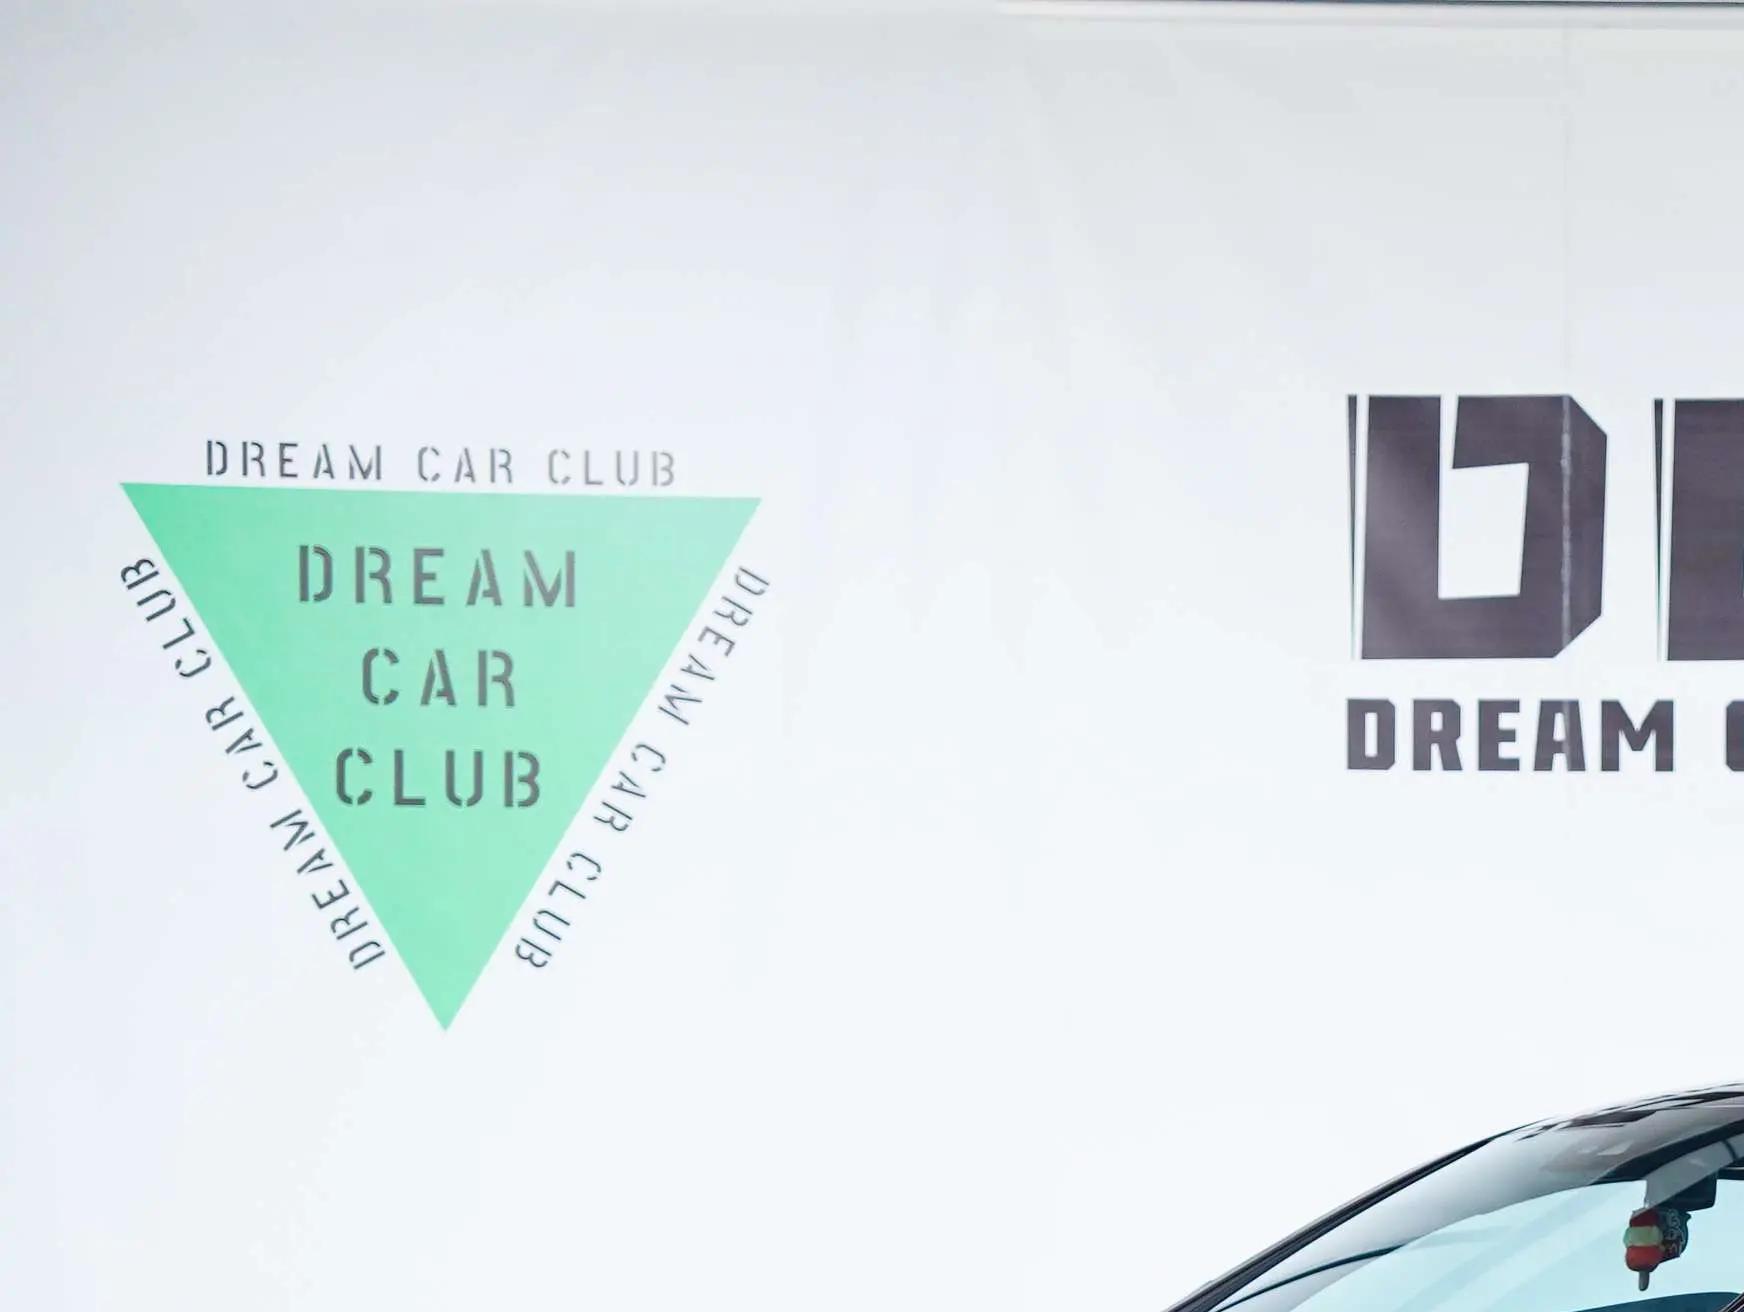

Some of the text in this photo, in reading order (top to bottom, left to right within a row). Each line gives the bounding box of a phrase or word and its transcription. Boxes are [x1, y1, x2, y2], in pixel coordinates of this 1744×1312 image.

[206, 440, 675, 487] DREAM CAR CLUB
[298, 544, 577, 608] DREAM
[361, 647, 515, 709] CAR
[121, 558, 386, 970] DREAM CAR CLUB
[1346, 698, 1674, 773] DREAM
[335, 747, 541, 809] CLUB
[514, 567, 770, 969] DREAM CAR CLUB
